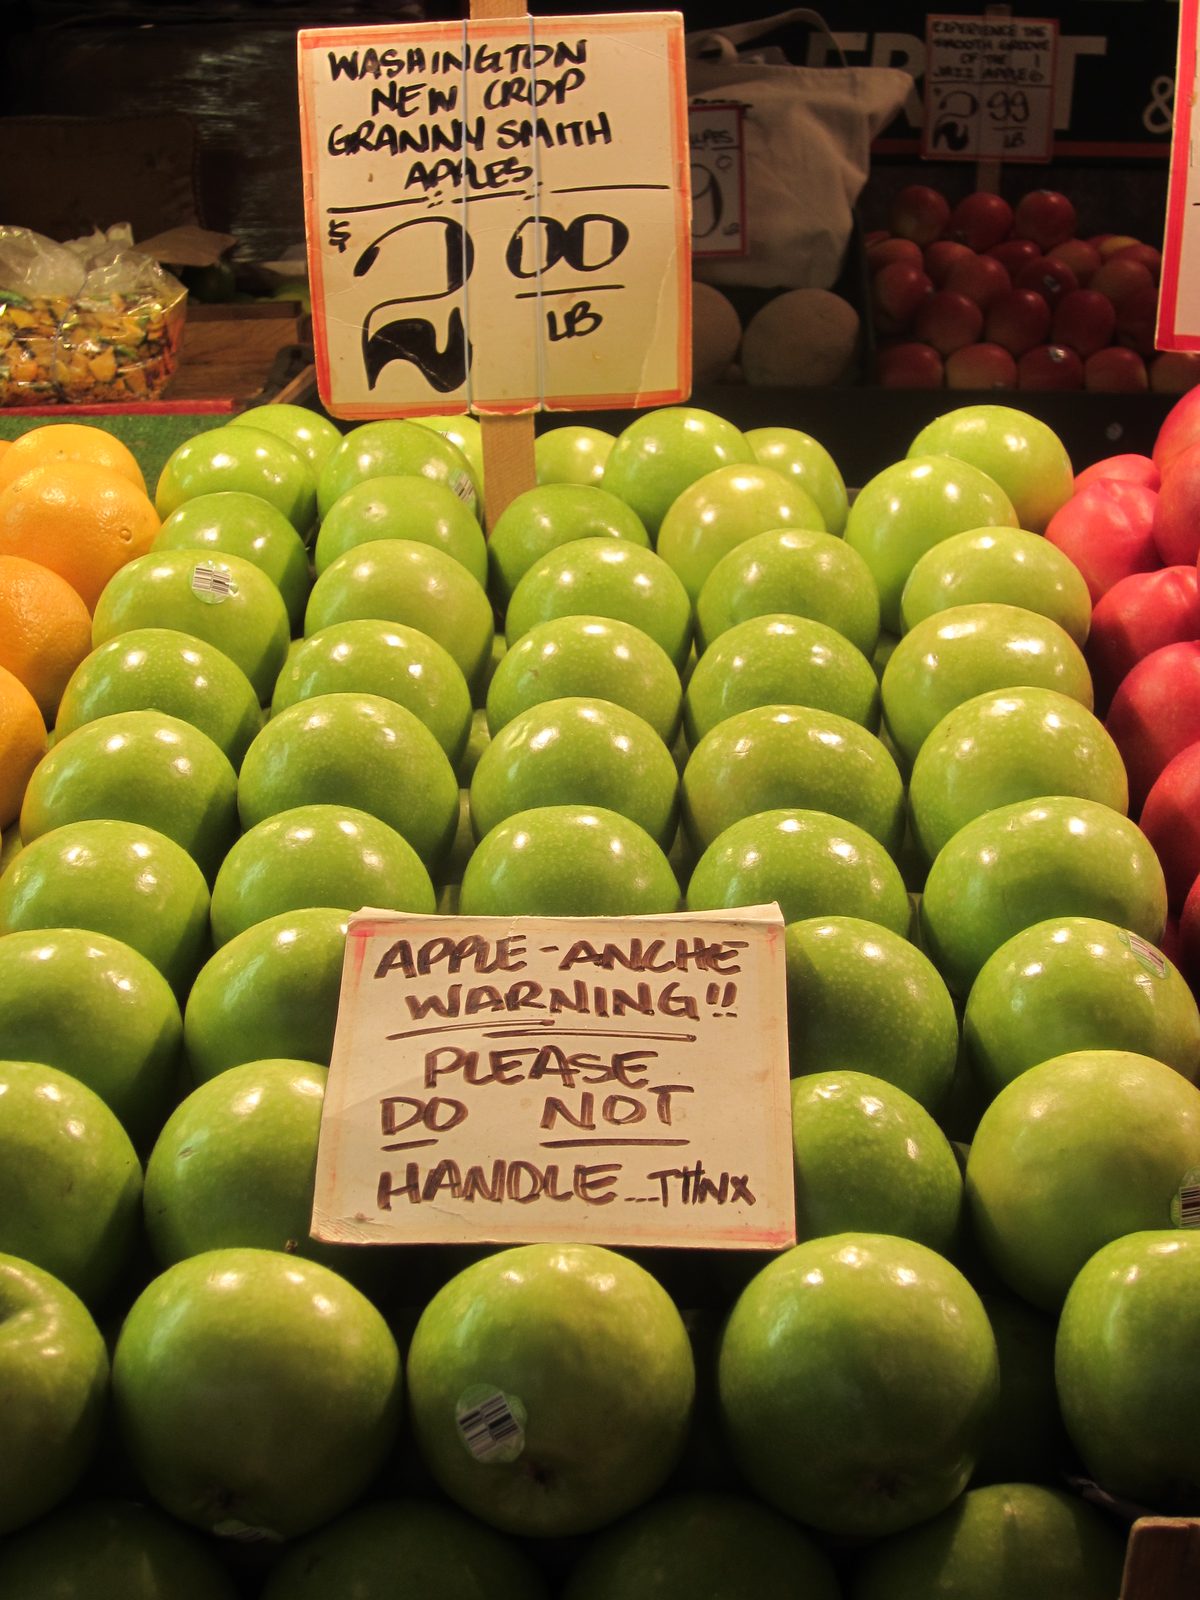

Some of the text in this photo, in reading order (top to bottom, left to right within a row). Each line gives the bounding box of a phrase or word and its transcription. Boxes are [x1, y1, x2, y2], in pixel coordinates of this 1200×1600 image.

[932, 22, 1017, 36] EXPERIENCE
[328, 39, 588, 81] WASHINGTON
[371, 67, 586, 117] NEW CROP
[327, 111, 612, 156] GRANNY SMITH
[404, 156, 534, 191] APPLES
[547, 301, 603, 342] LB
[424, 1045, 659, 1089] PLEASE
[380, 1085, 695, 1136] DO NOT
